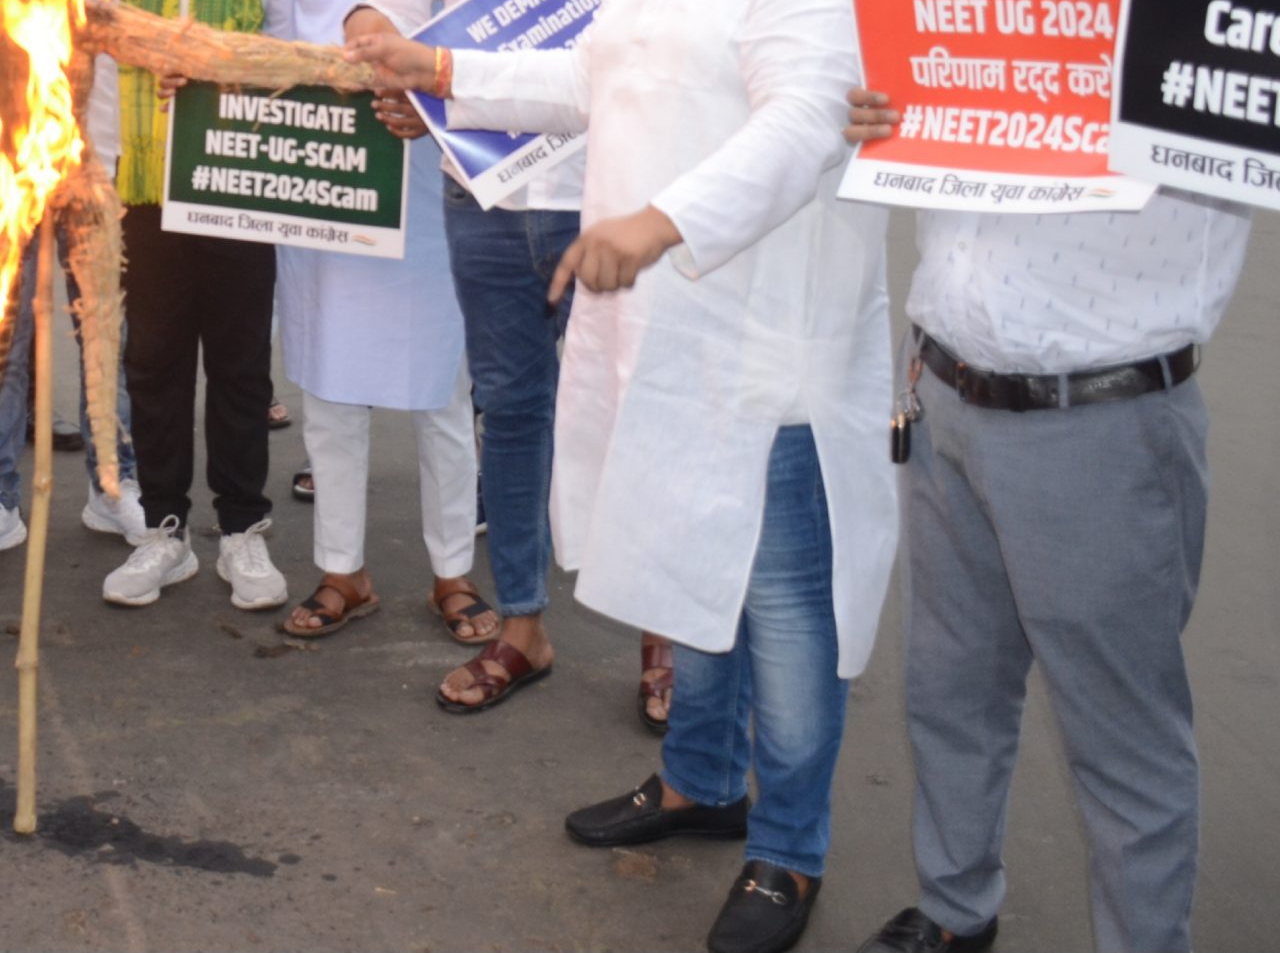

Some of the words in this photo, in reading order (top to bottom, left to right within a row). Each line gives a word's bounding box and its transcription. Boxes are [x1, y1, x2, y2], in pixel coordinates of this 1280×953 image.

[466, 13, 498, 44] WE
[1041, 0, 1115, 39] 2024
[910, 44, 1006, 92] परिणाम
[218, 93, 356, 134] INVESTIGATE
[899, 104, 1110, 155] #NEET2024Sca
[204, 128, 368, 174] NEET-UG-SCAM
[1150, 143, 1236, 182] धनबाद
[191, 165, 379, 212] #NEET2024Scam
[872, 170, 934, 193] धनबाद
[939, 172, 985, 198] जिला
[990, 180, 1023, 204] युवा
[1027, 179, 1086, 204] कांग्रेस
[186, 211, 234, 229] धनबाद
[238, 213, 274, 233] जिला
[277, 221, 303, 240] युवा
[306, 223, 349, 244] कांग्रेस
